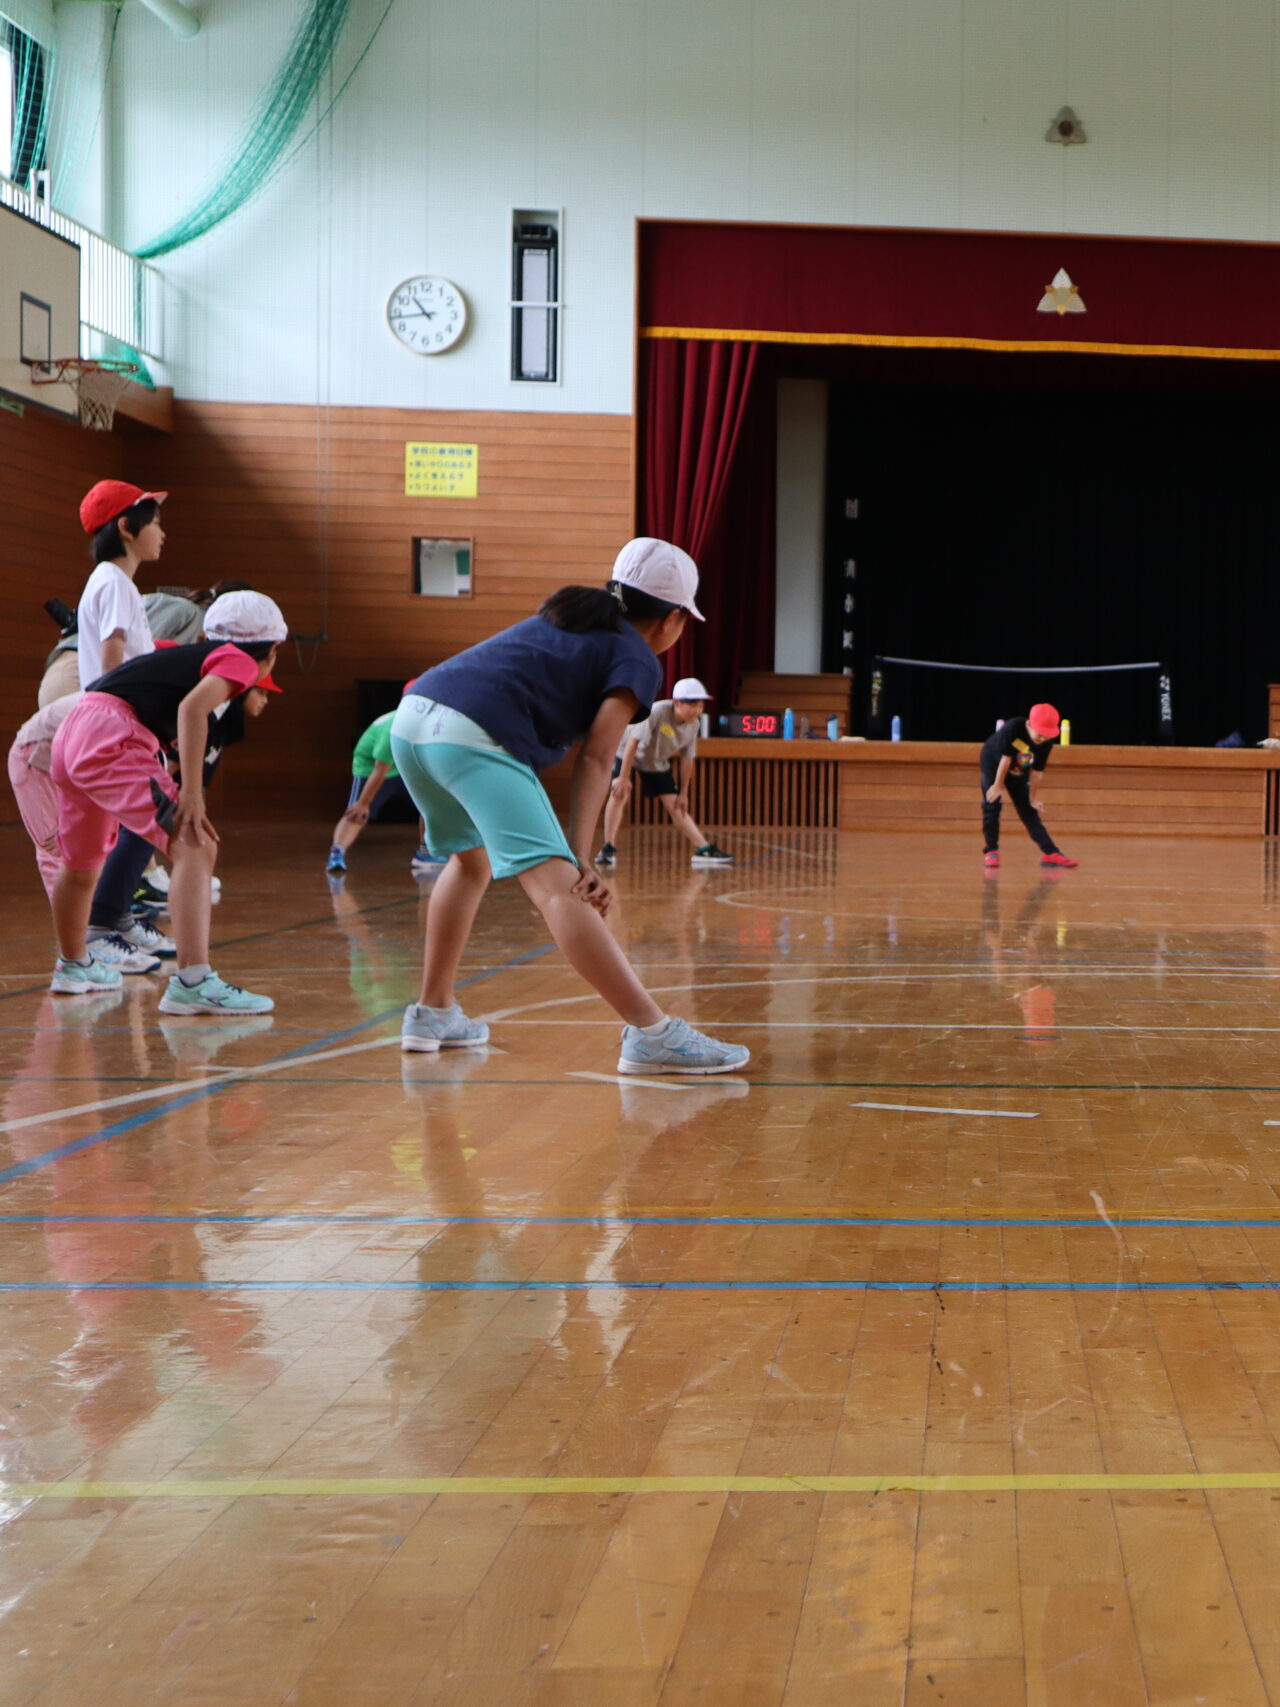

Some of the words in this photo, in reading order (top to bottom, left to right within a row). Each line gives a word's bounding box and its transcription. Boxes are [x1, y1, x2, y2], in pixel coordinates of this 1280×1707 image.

[408, 284, 418, 296] 11
[420, 281, 432, 293] 12
[398, 295, 410, 306] 10
[446, 296, 454, 306] 2
[450, 310, 458, 320] 3
[398, 321, 406, 332] 8
[445, 324, 452, 334] 4
[410, 330, 417, 342] 7
[422, 335, 430, 347] 6
[436, 332, 444, 342] 5
[1160, 692, 1172, 722] YONEX
[742, 715, 777, 733] 5:00
